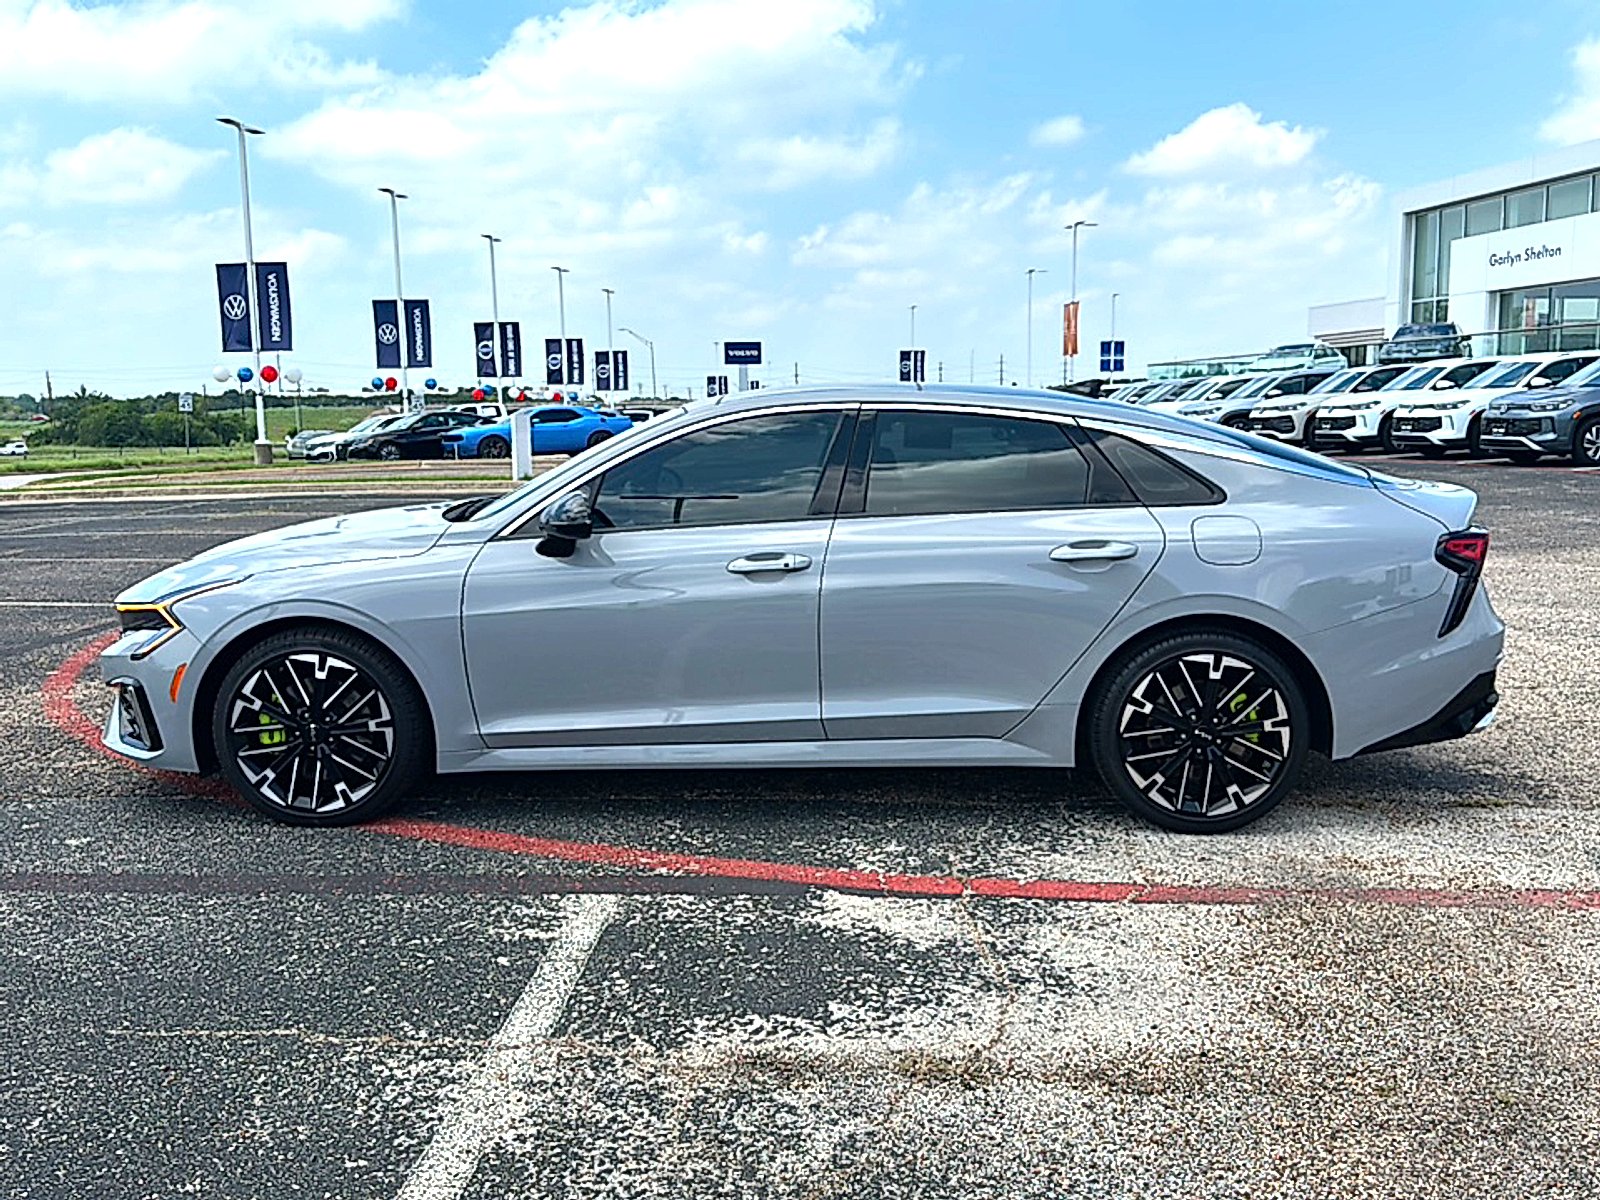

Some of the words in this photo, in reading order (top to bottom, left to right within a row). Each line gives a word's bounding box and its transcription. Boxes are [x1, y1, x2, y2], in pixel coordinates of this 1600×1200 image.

[1524, 244, 1562, 262] Shelton
[267, 272, 282, 342] VOLKSWAGEN
[413, 307, 425, 362] VOLKSWAGEN
[727, 349, 759, 357] VOLVO
